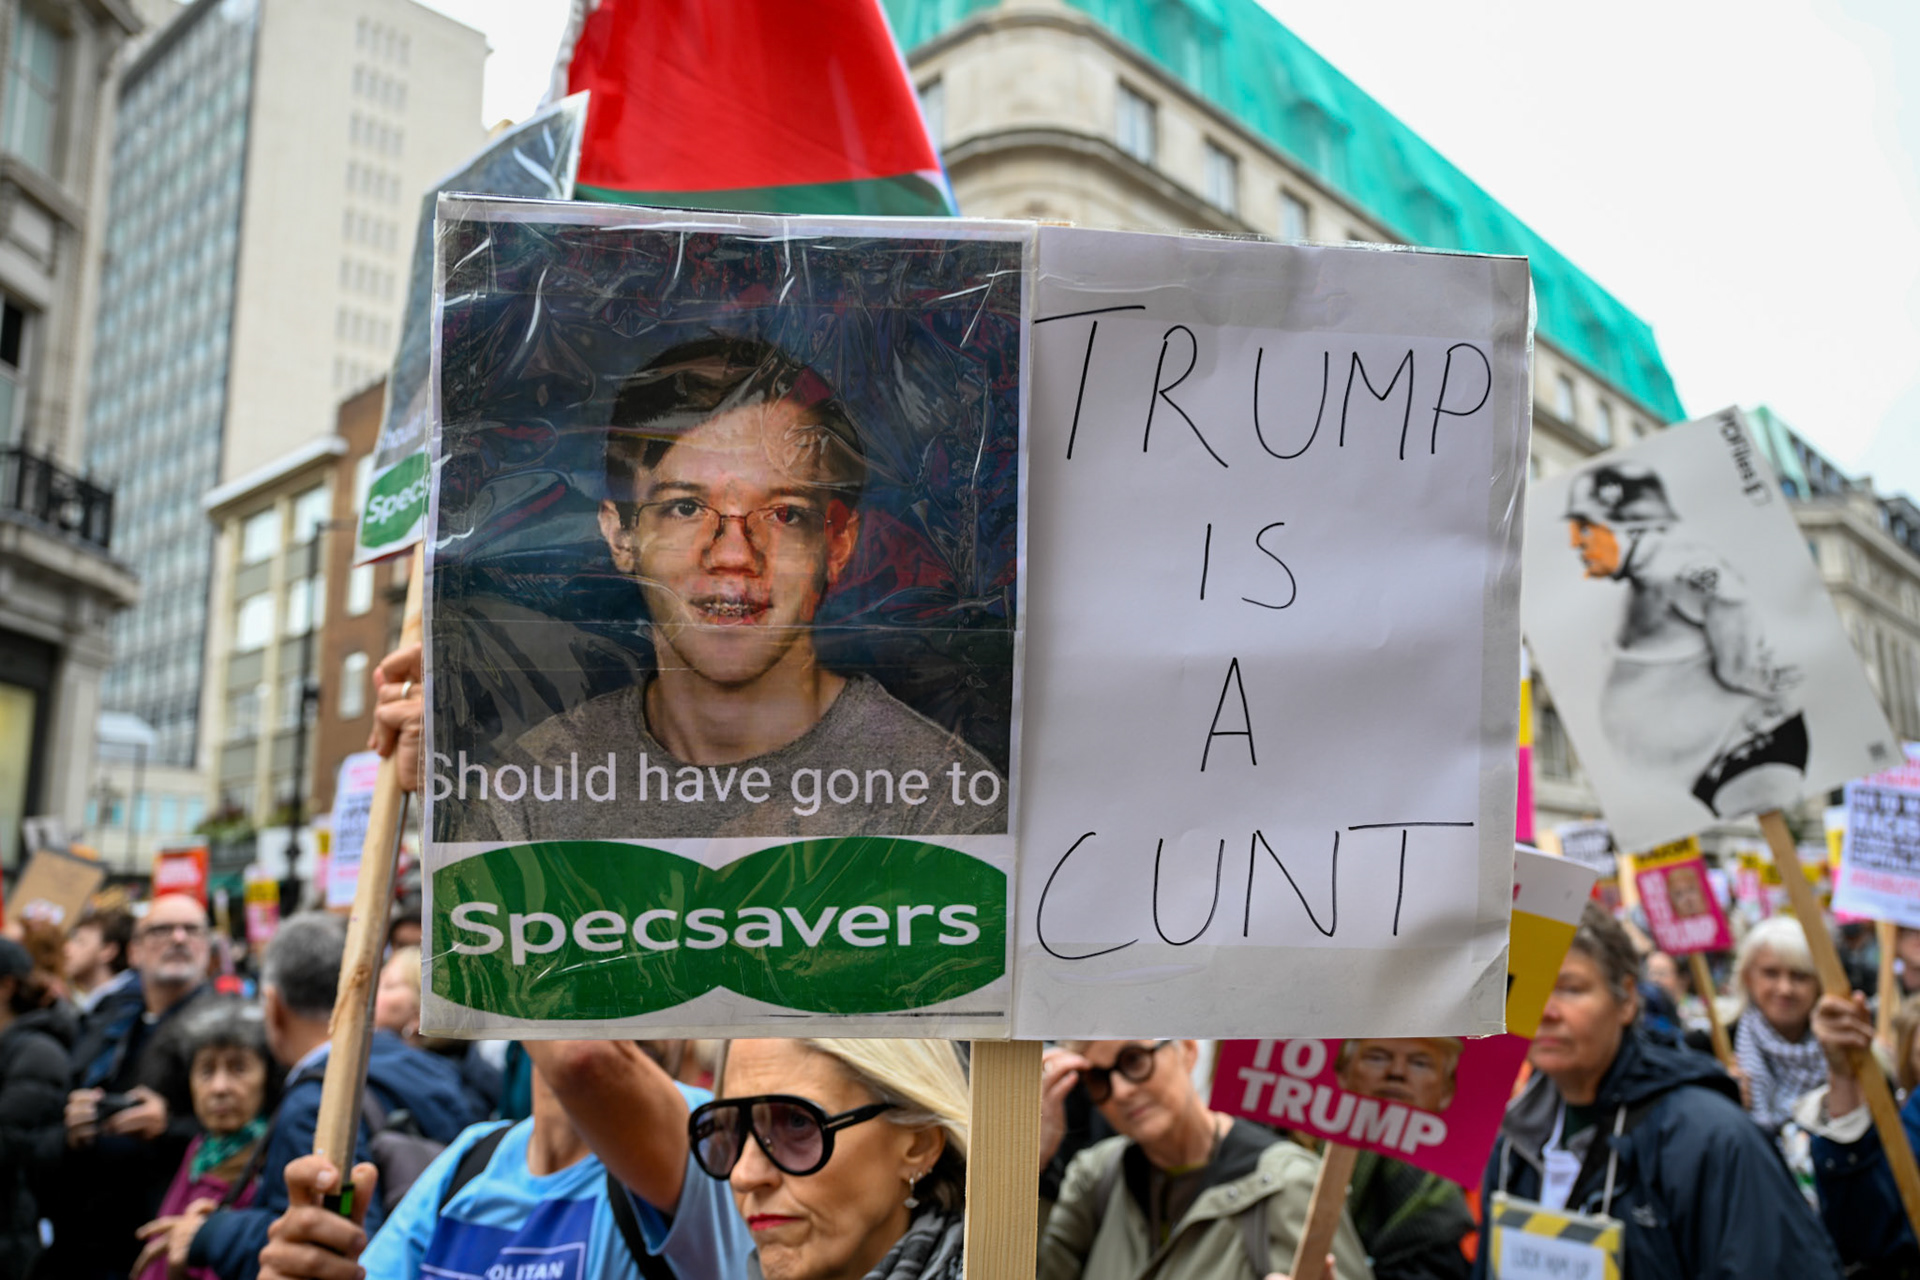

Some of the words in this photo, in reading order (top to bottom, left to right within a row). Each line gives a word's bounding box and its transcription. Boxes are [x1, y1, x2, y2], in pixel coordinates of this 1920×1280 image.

[1034, 305, 1492, 468] TRUMP
[1201, 522, 1297, 610] IS
[1200, 657, 1257, 772] A
[433, 750, 617, 802] Should
[640, 753, 772, 802] have
[790, 764, 930, 817] gone
[946, 761, 1002, 806] to
[450, 901, 980, 966] Specsavers
[1036, 822, 1475, 960] CUNT
[1252, 1039, 1328, 1079] TO
[1238, 1066, 1448, 1155] TRUMP
